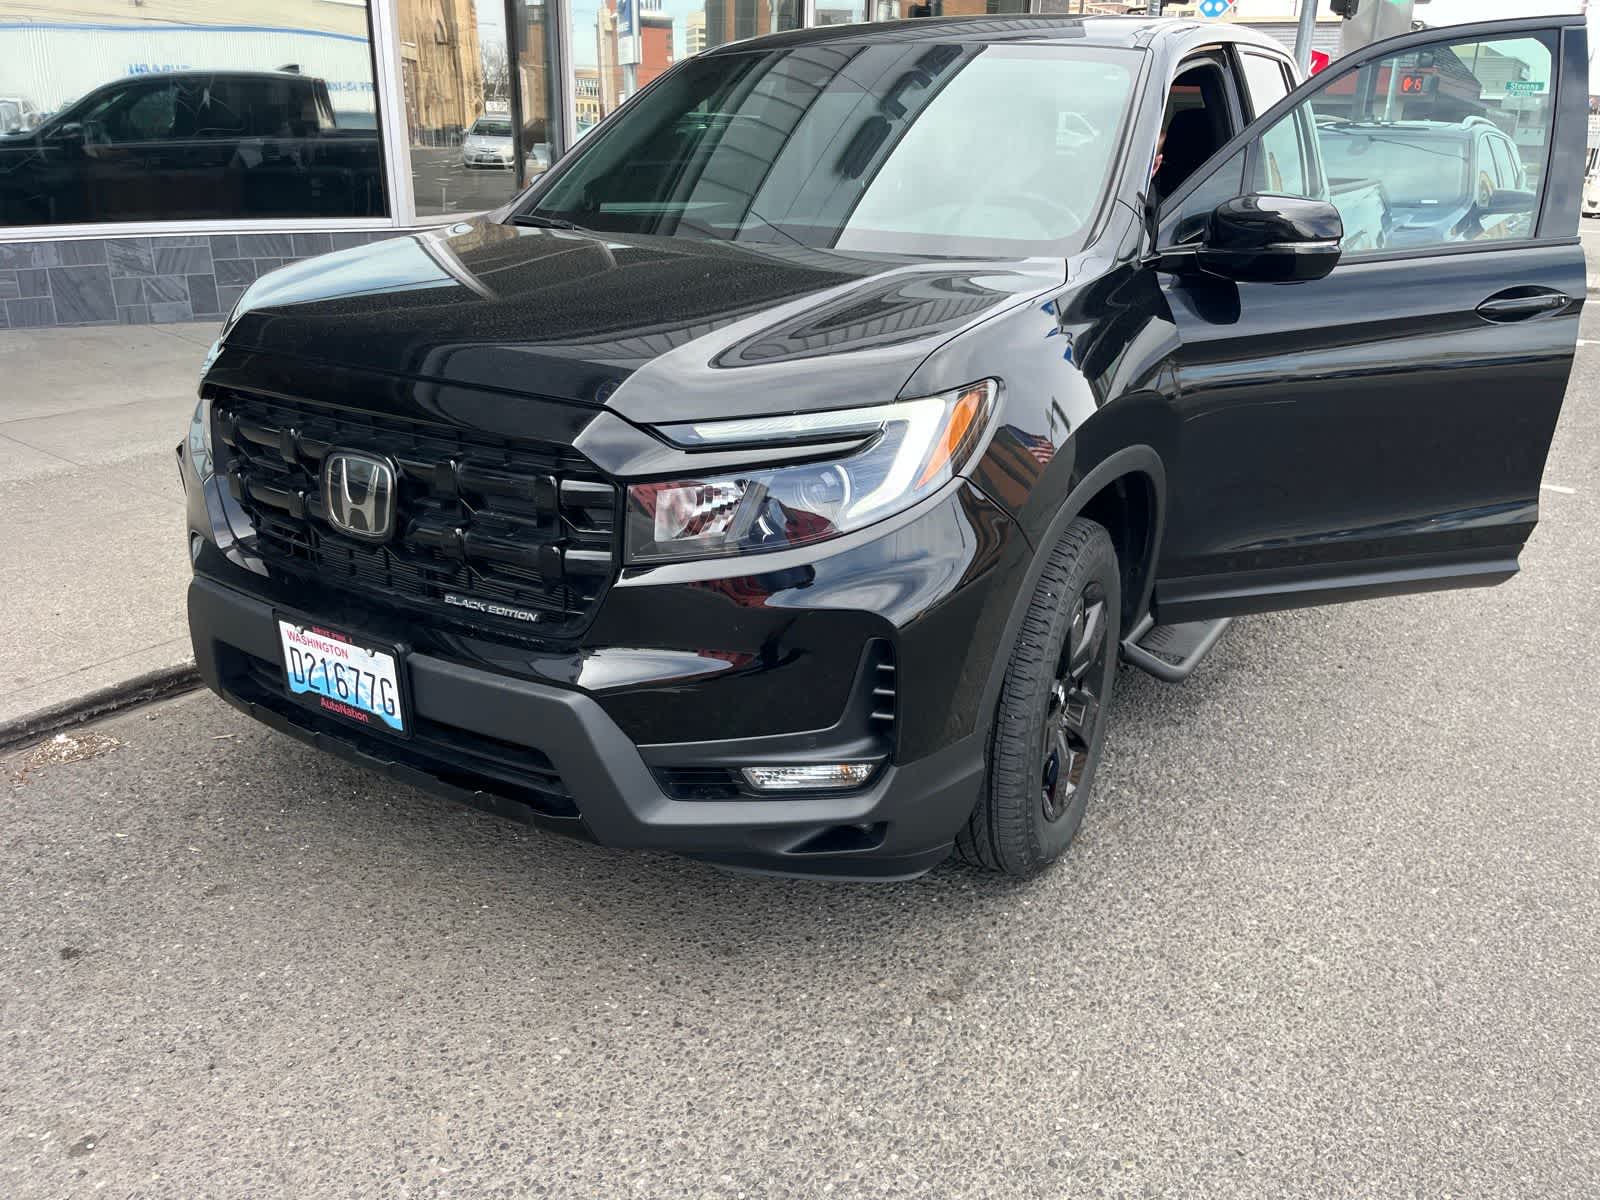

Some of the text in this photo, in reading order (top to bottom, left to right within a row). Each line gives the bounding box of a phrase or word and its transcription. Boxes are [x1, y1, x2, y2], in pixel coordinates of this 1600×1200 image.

[1510, 82, 1540, 91] Stevens
[444, 594, 538, 622] BLACK EDITION
[287, 629, 349, 659] WASHINGTON
[289, 646, 395, 716] D21677G
[320, 697, 369, 722] AutoNation
